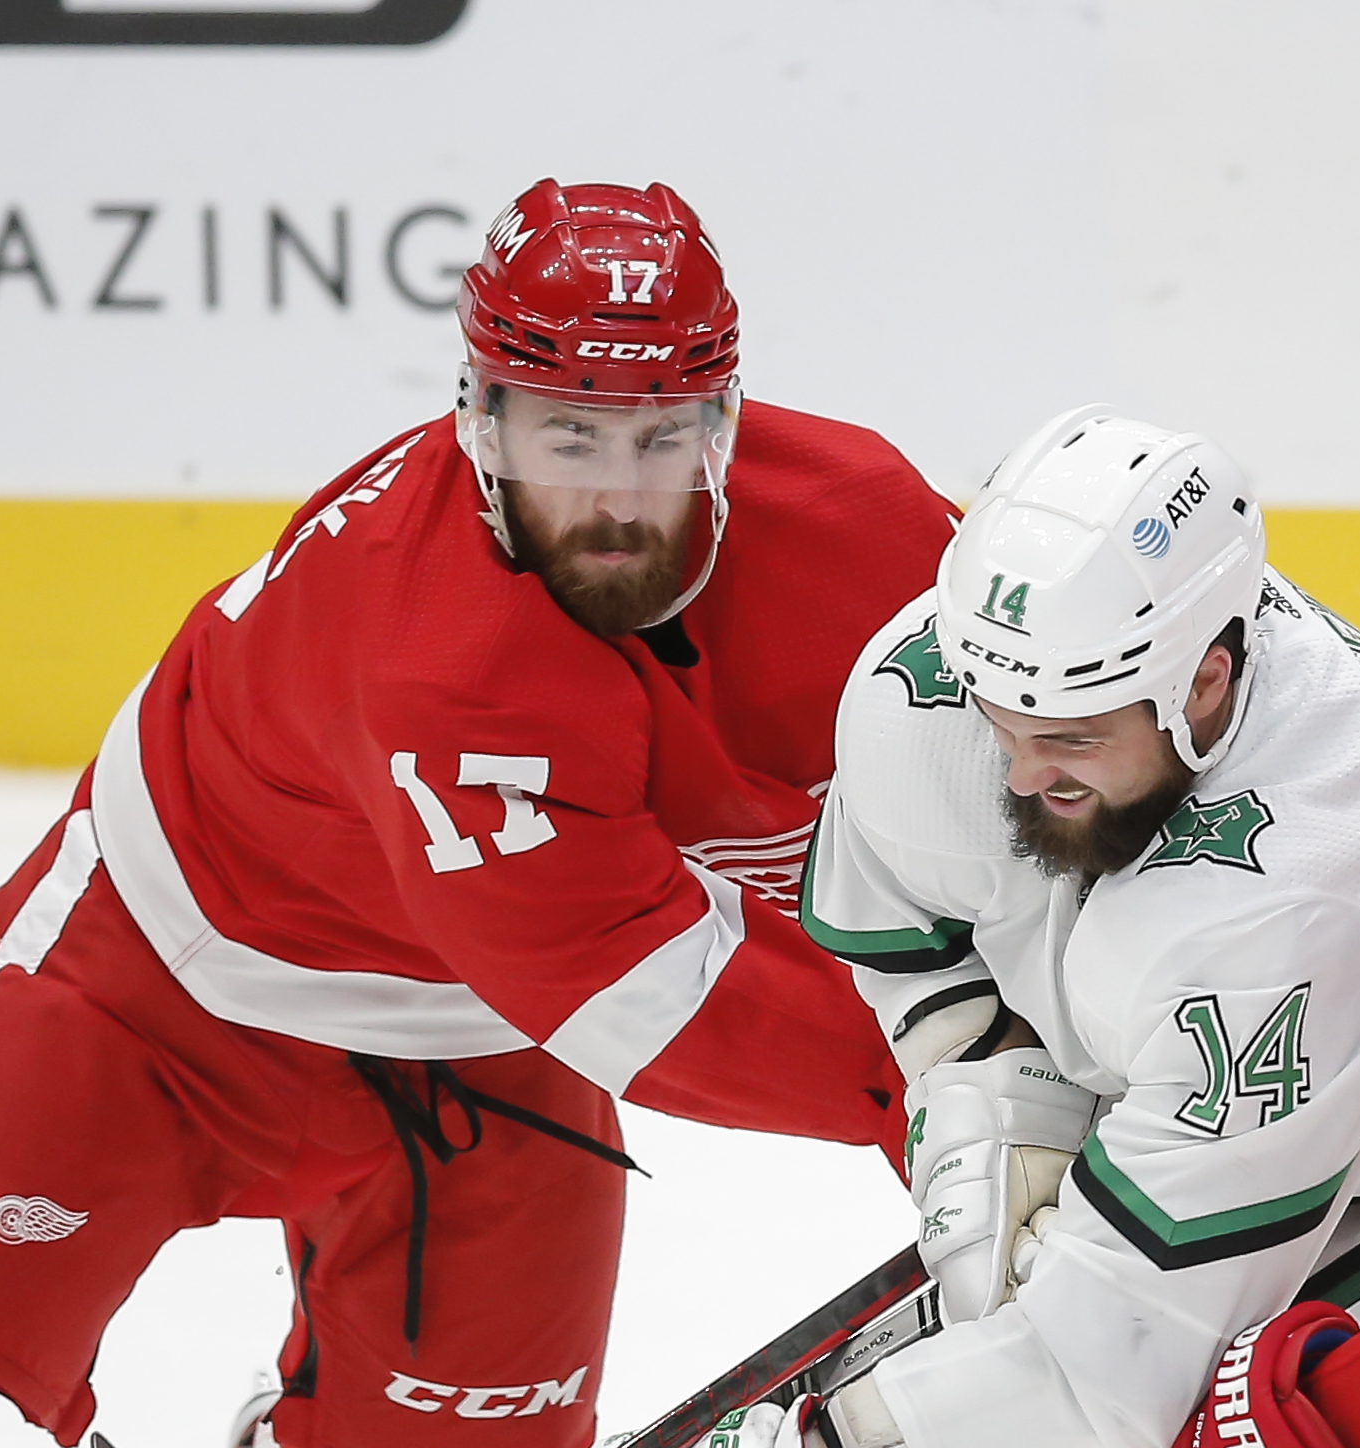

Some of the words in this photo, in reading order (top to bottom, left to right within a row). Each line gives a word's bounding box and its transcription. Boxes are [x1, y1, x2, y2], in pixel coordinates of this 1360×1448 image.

[488, 200, 538, 264] WM
[607, 260, 658, 304] 17
[576, 340, 675, 362] CCM
[1163, 466, 1212, 530] AT&T
[980, 572, 1031, 627] 14
[1261, 577, 1302, 619] adida
[959, 637, 1041, 678] CCM
[390, 750, 558, 874] 17
[1174, 978, 1312, 1138] 14
[383, 1366, 589, 1420] CCM
